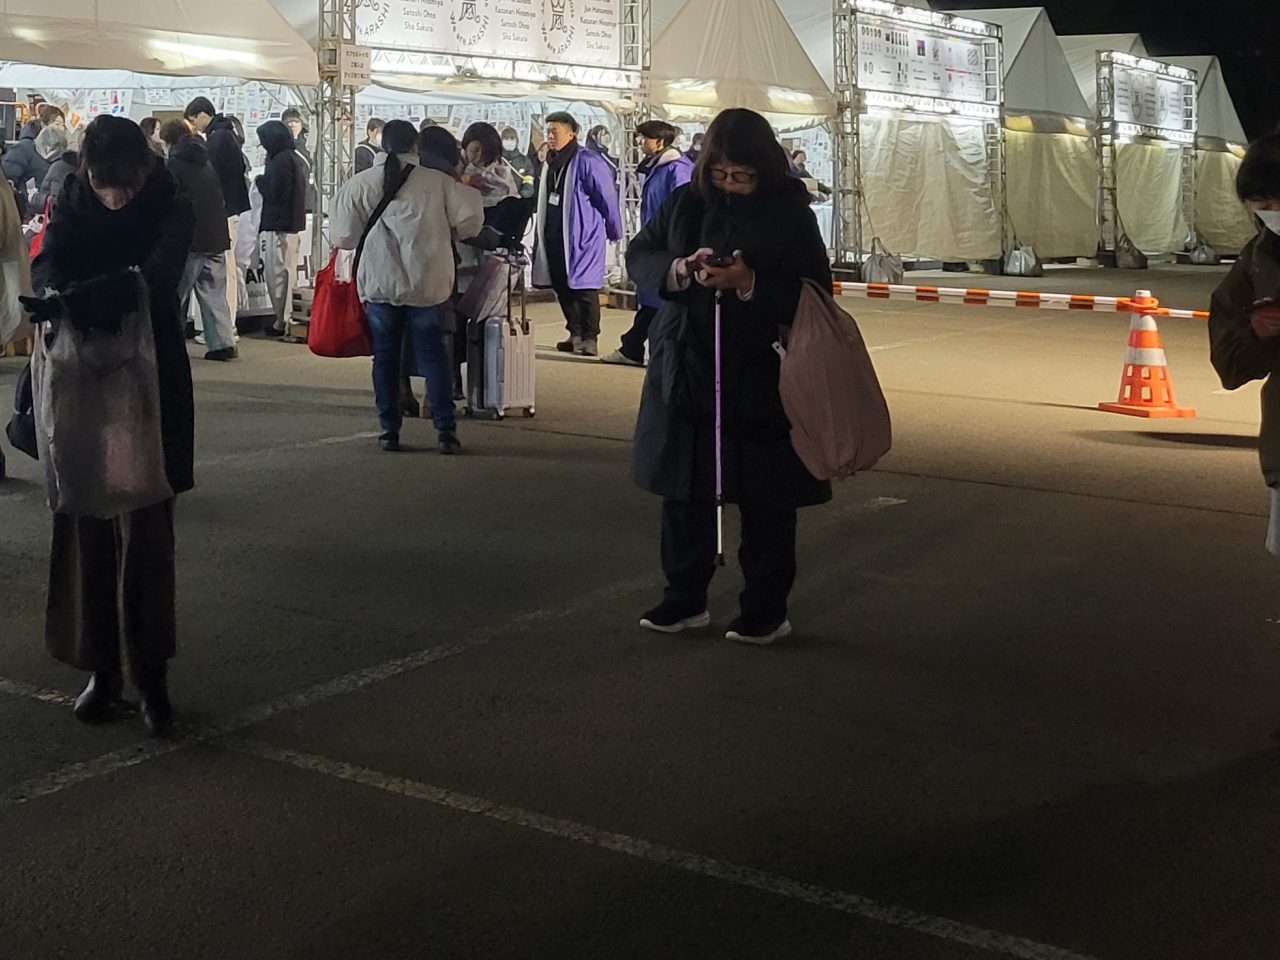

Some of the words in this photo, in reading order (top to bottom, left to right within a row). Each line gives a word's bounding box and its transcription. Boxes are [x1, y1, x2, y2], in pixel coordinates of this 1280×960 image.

[403, 7, 422, 16] Satoshi
[364, 2, 390, 37] ARASHI
[404, 21, 415, 30] Sho
